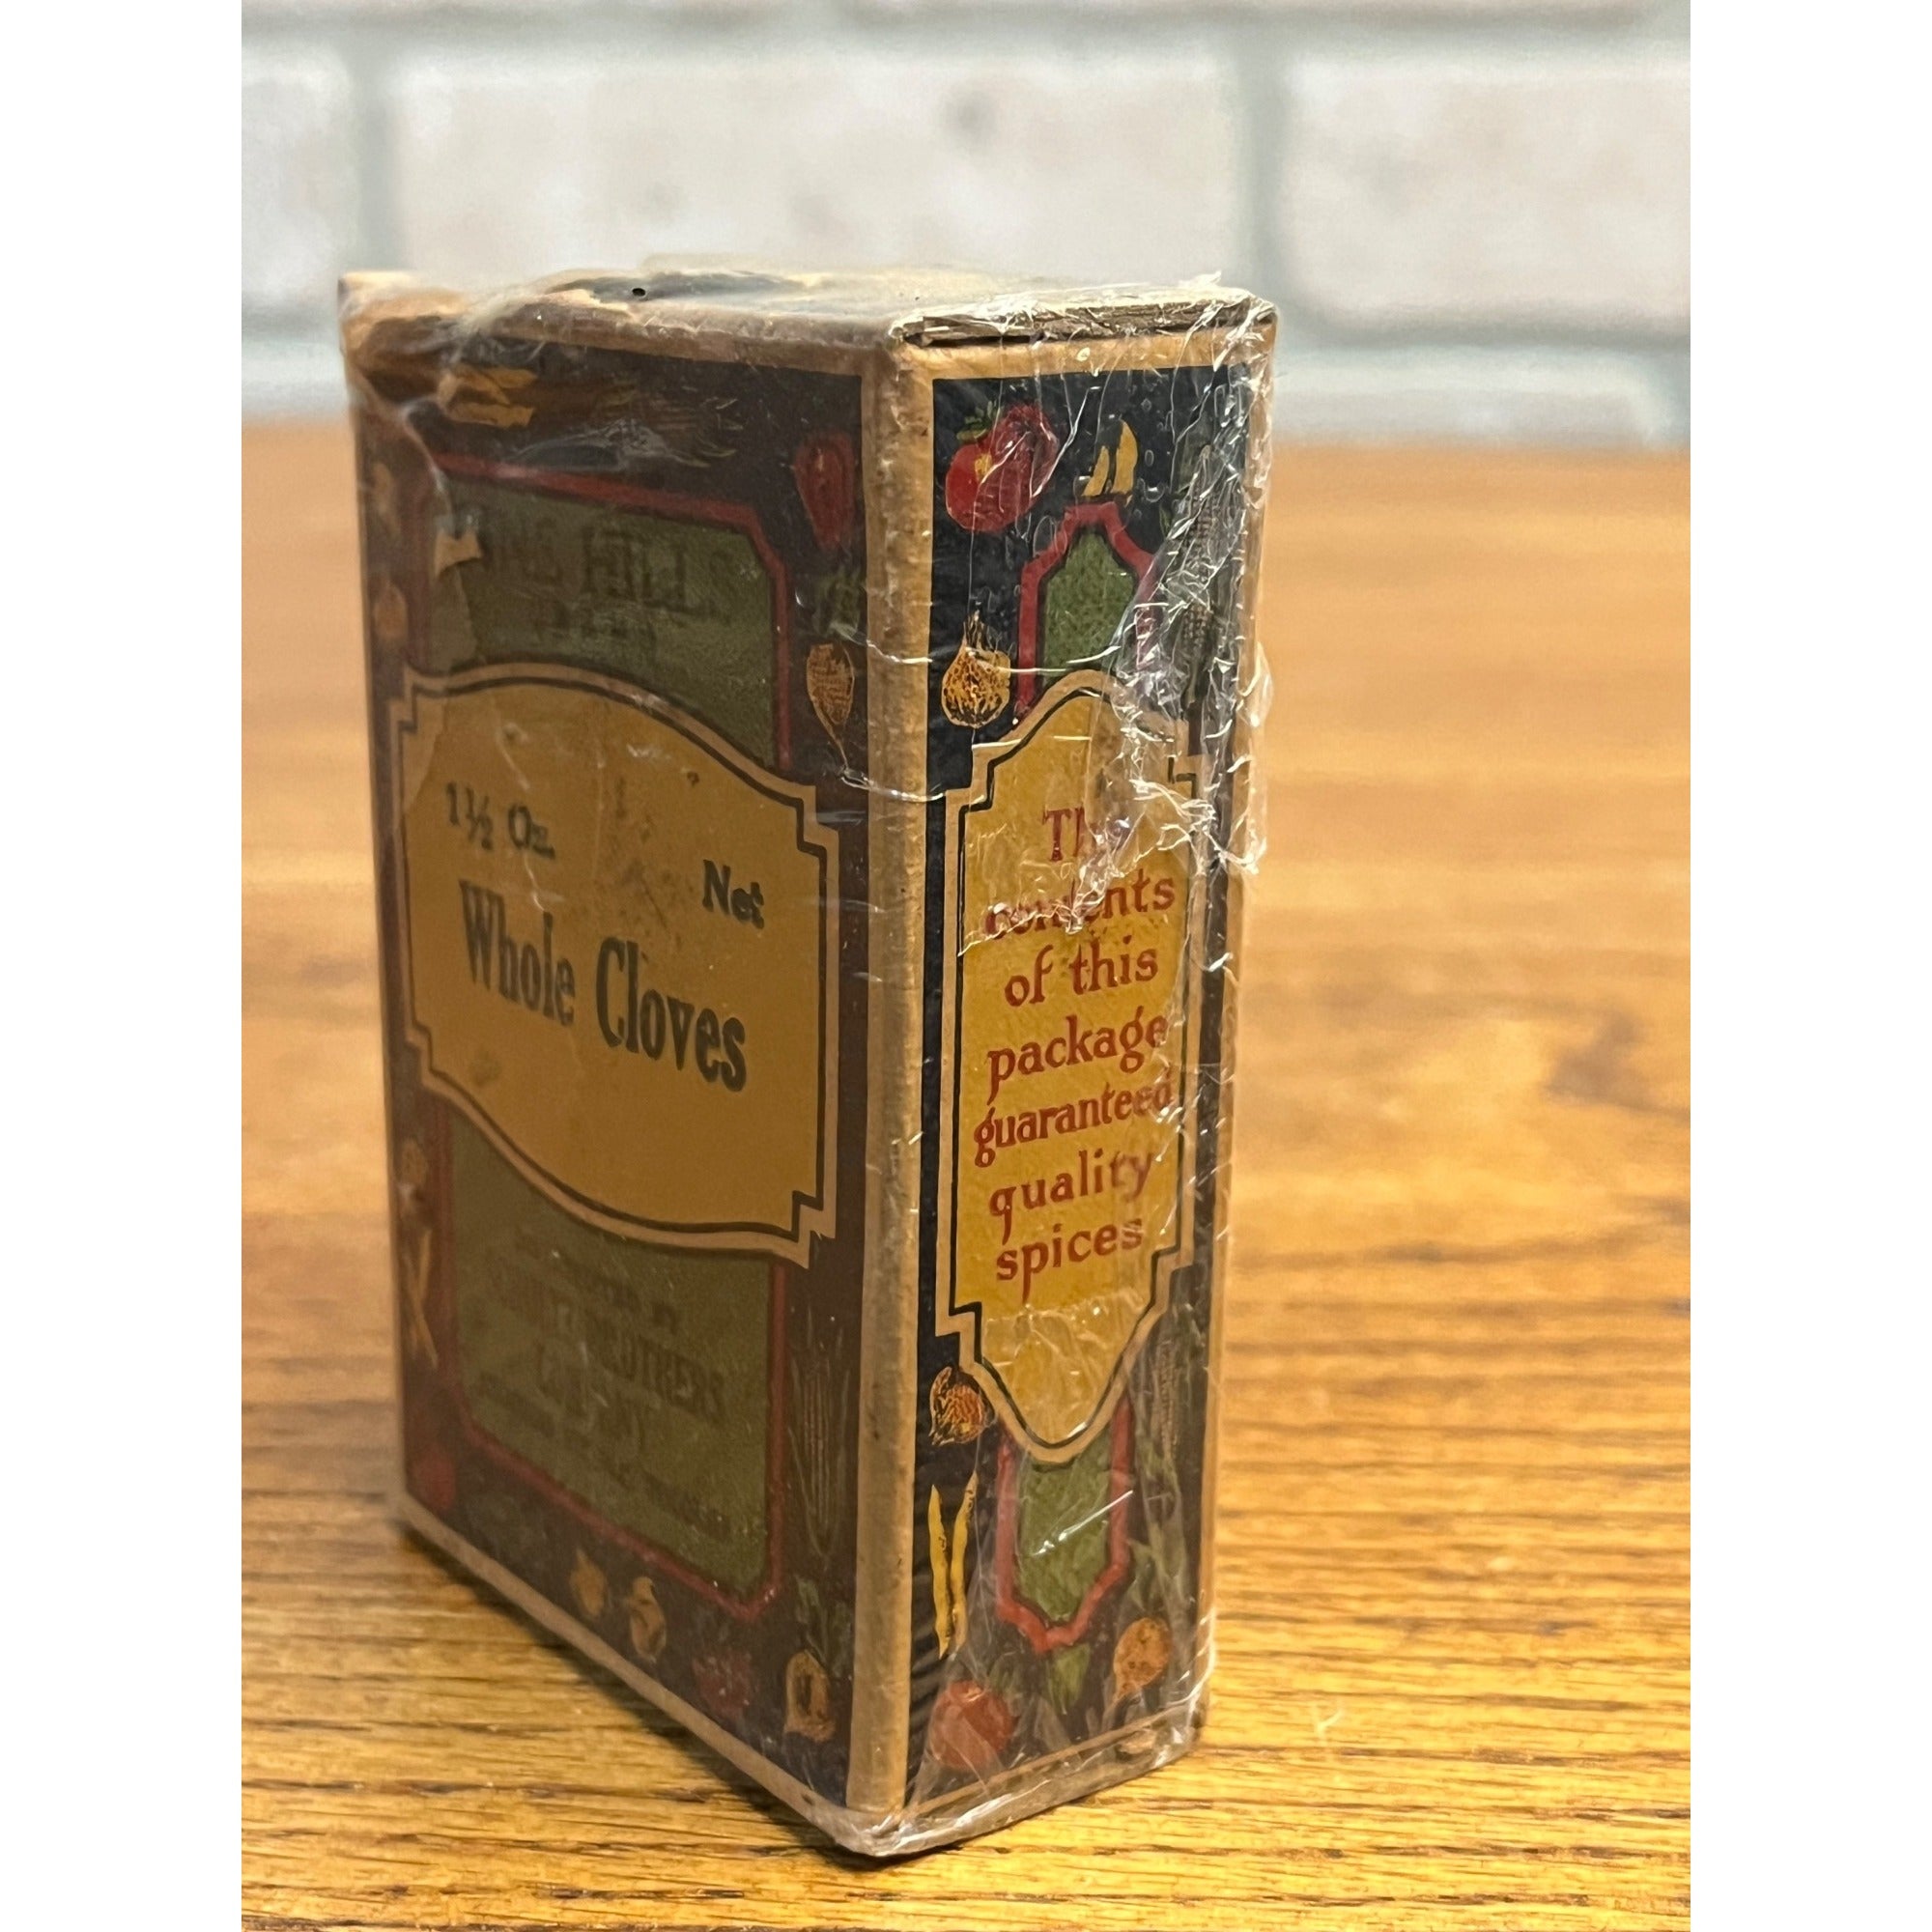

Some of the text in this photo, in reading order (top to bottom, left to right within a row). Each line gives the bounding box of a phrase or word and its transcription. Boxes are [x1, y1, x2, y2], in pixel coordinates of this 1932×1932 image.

[701, 858, 765, 930] Net
[458, 878, 748, 1093] Whole Cloves
[1004, 934, 1159, 1008] of this
[986, 1005, 1170, 1106] package
[973, 1065, 1173, 1168] guaranteed
[988, 1148, 1154, 1246] quality
[995, 1217, 1144, 1304] spices
